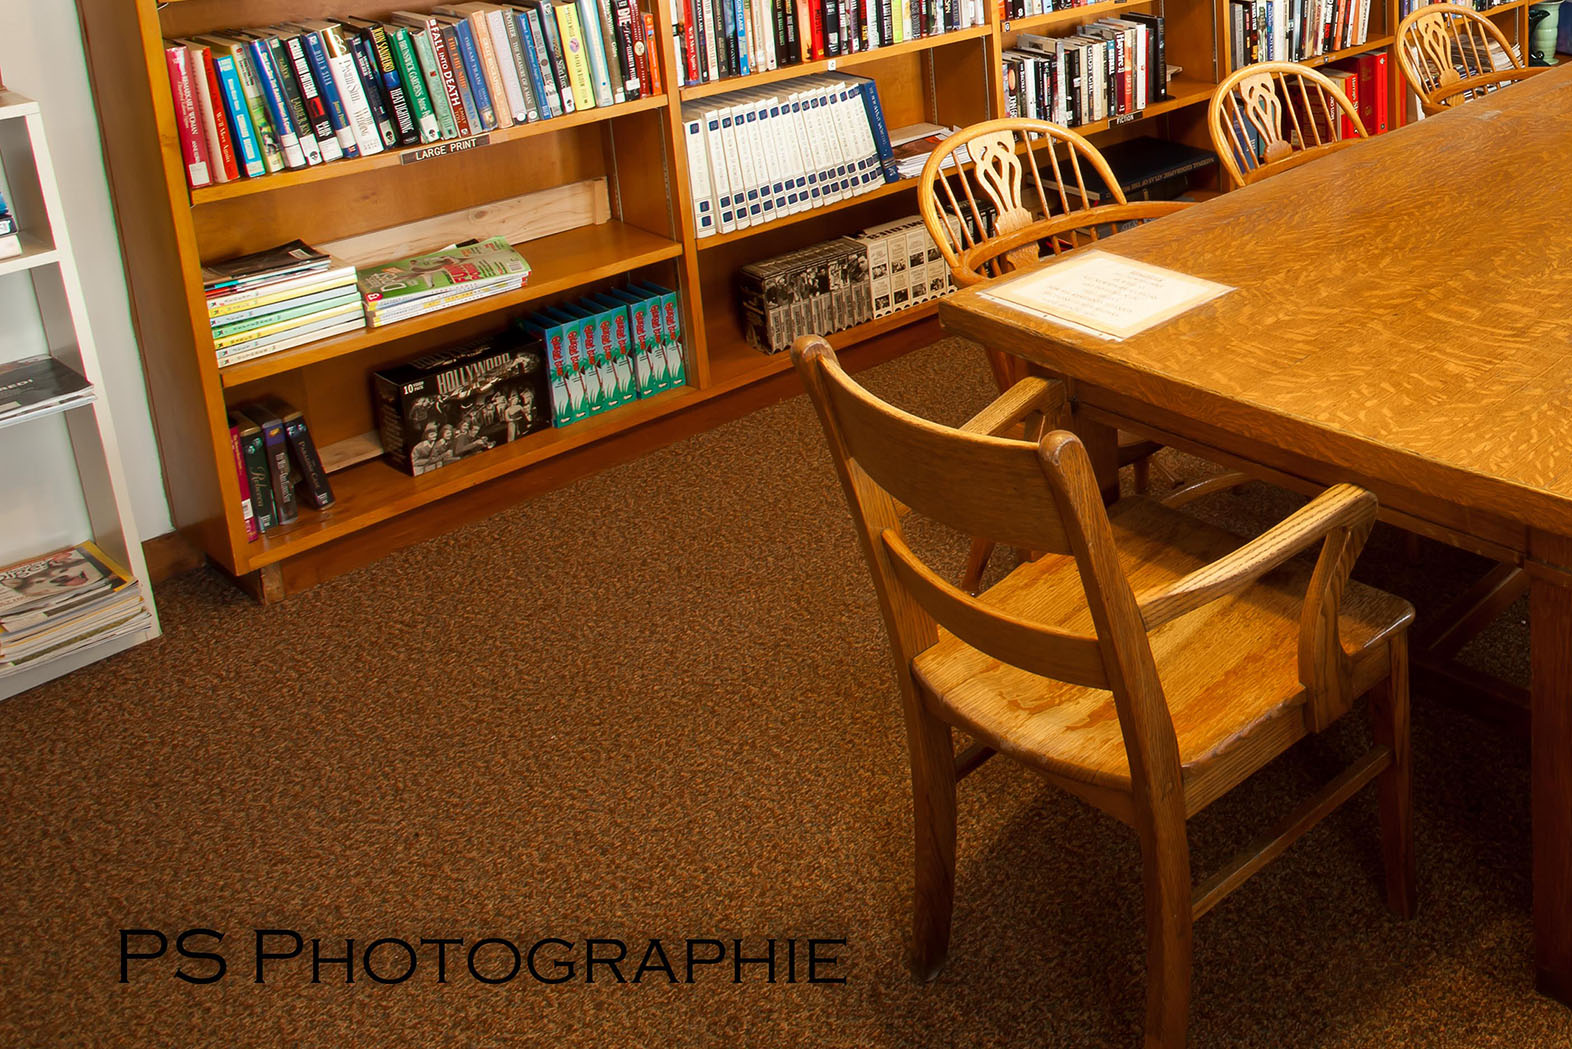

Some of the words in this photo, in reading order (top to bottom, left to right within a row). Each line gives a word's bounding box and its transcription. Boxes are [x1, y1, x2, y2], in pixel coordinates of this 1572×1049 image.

[1117, 114, 1134, 125] FICTION
[415, 146, 446, 161] LARGE
[450, 139, 477, 153] PRINT
[436, 353, 511, 395] HOLLYWOOD
[403, 385, 414, 396] 10
